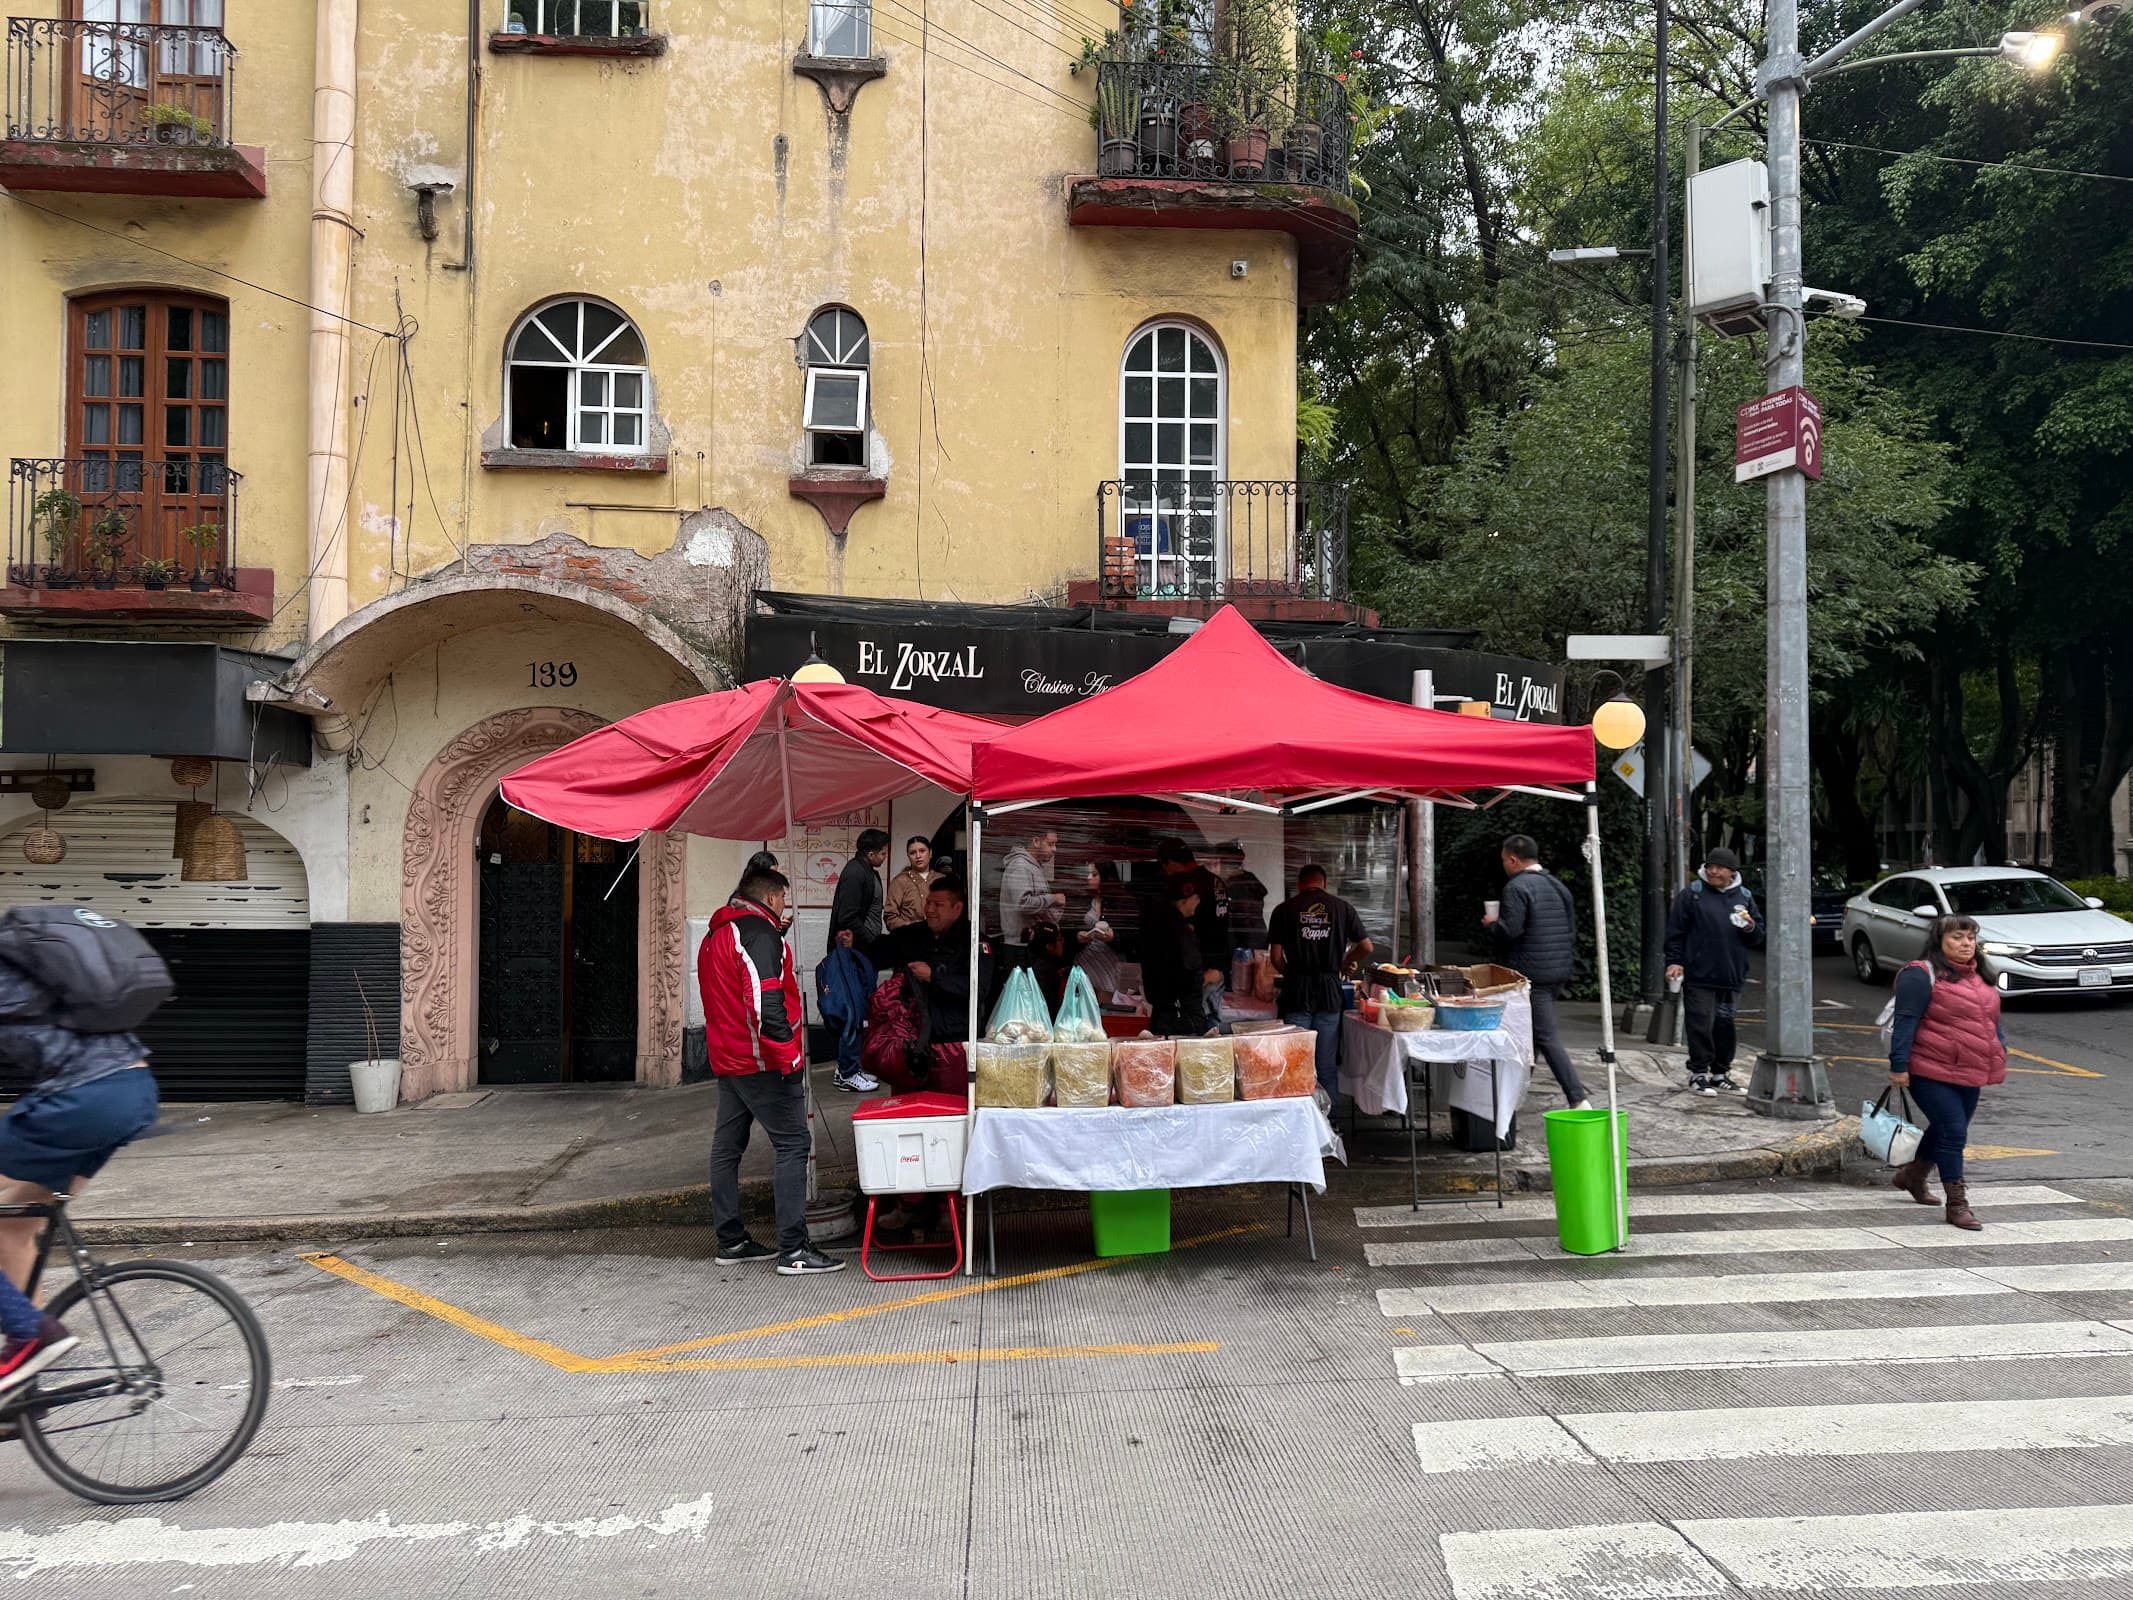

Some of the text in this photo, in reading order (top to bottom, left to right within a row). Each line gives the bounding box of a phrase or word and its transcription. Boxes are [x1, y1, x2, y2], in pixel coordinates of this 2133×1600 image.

[525, 661, 578, 688] 139
[857, 641, 984, 690] EL ZORZAL
[1021, 669, 1074, 695] Clasico
[1494, 673, 1558, 721] EL ZORZAL
[1302, 927, 1331, 940] Rappi
